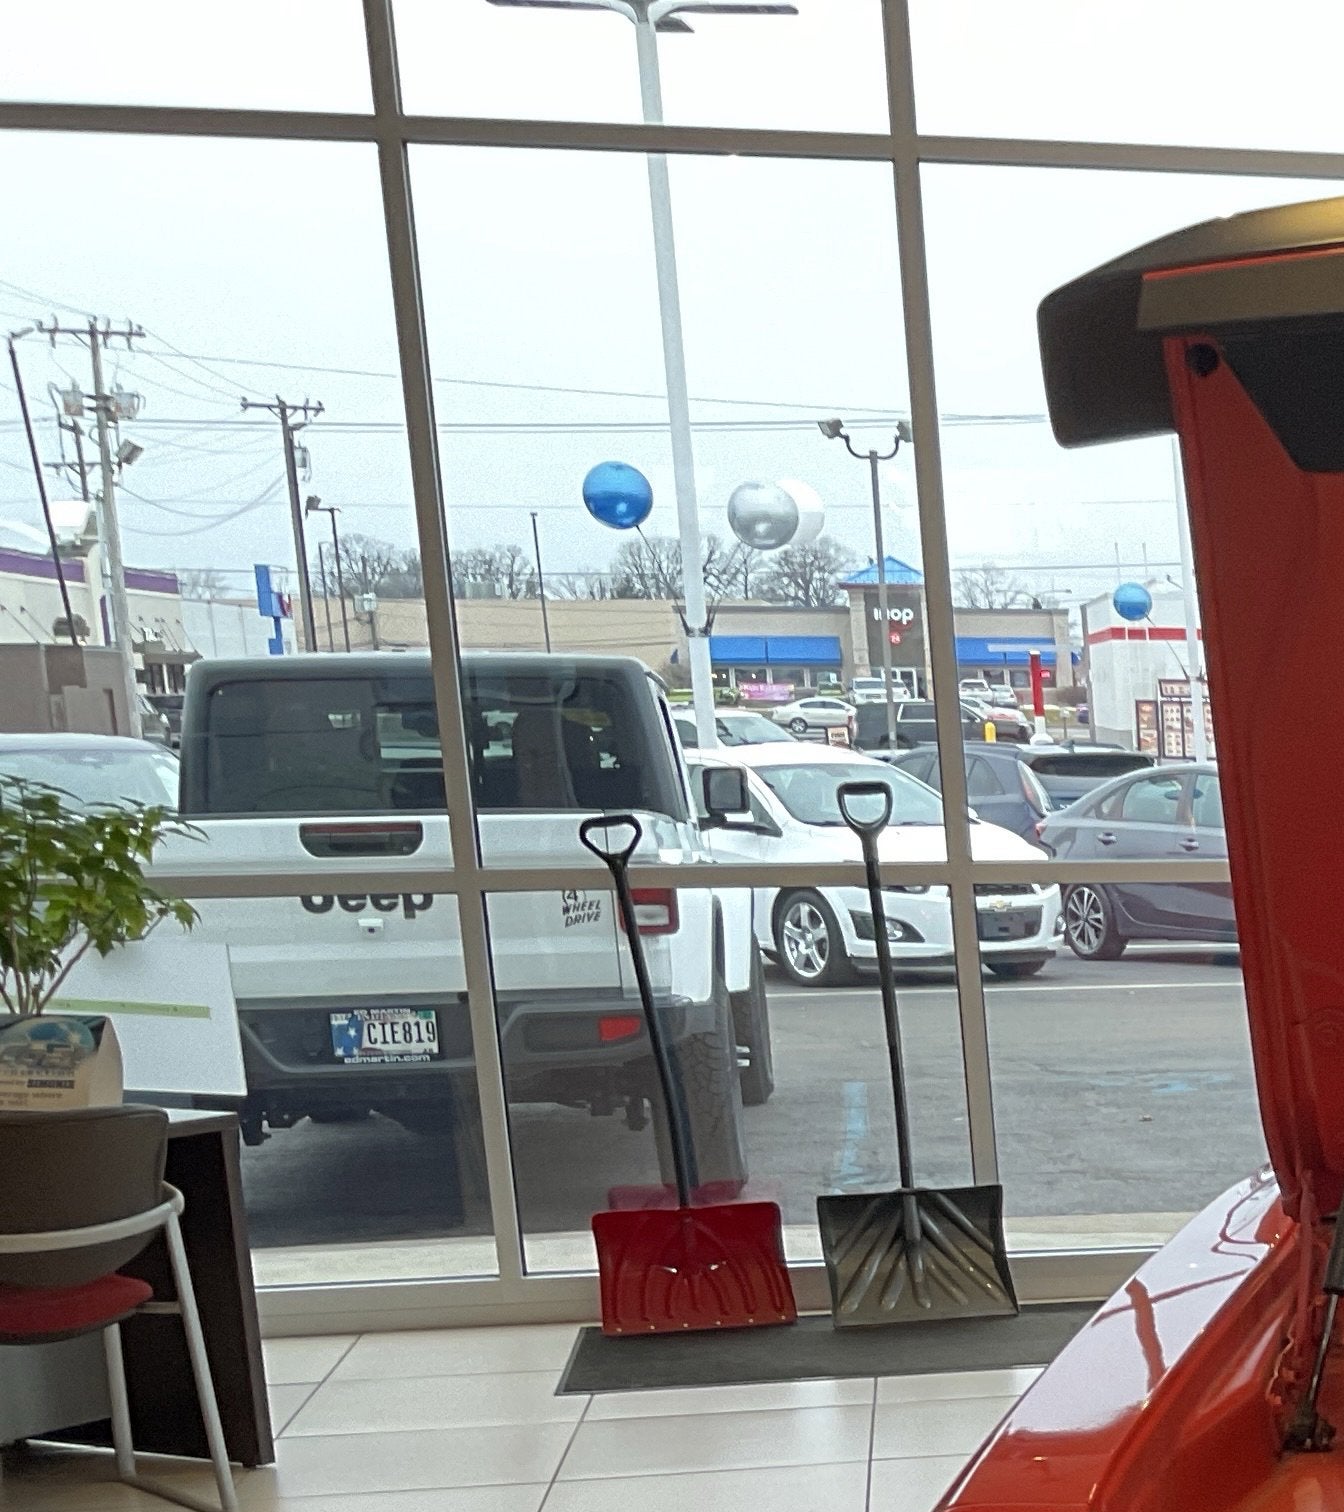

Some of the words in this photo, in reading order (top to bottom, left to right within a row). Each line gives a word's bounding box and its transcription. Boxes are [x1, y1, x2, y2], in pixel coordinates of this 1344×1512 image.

[562, 899, 601, 916] WHEEL
[564, 911, 601, 928] DRIVE
[367, 1020, 436, 1045] CIE819
[344, 1054, 431, 1064] edmartin.com
